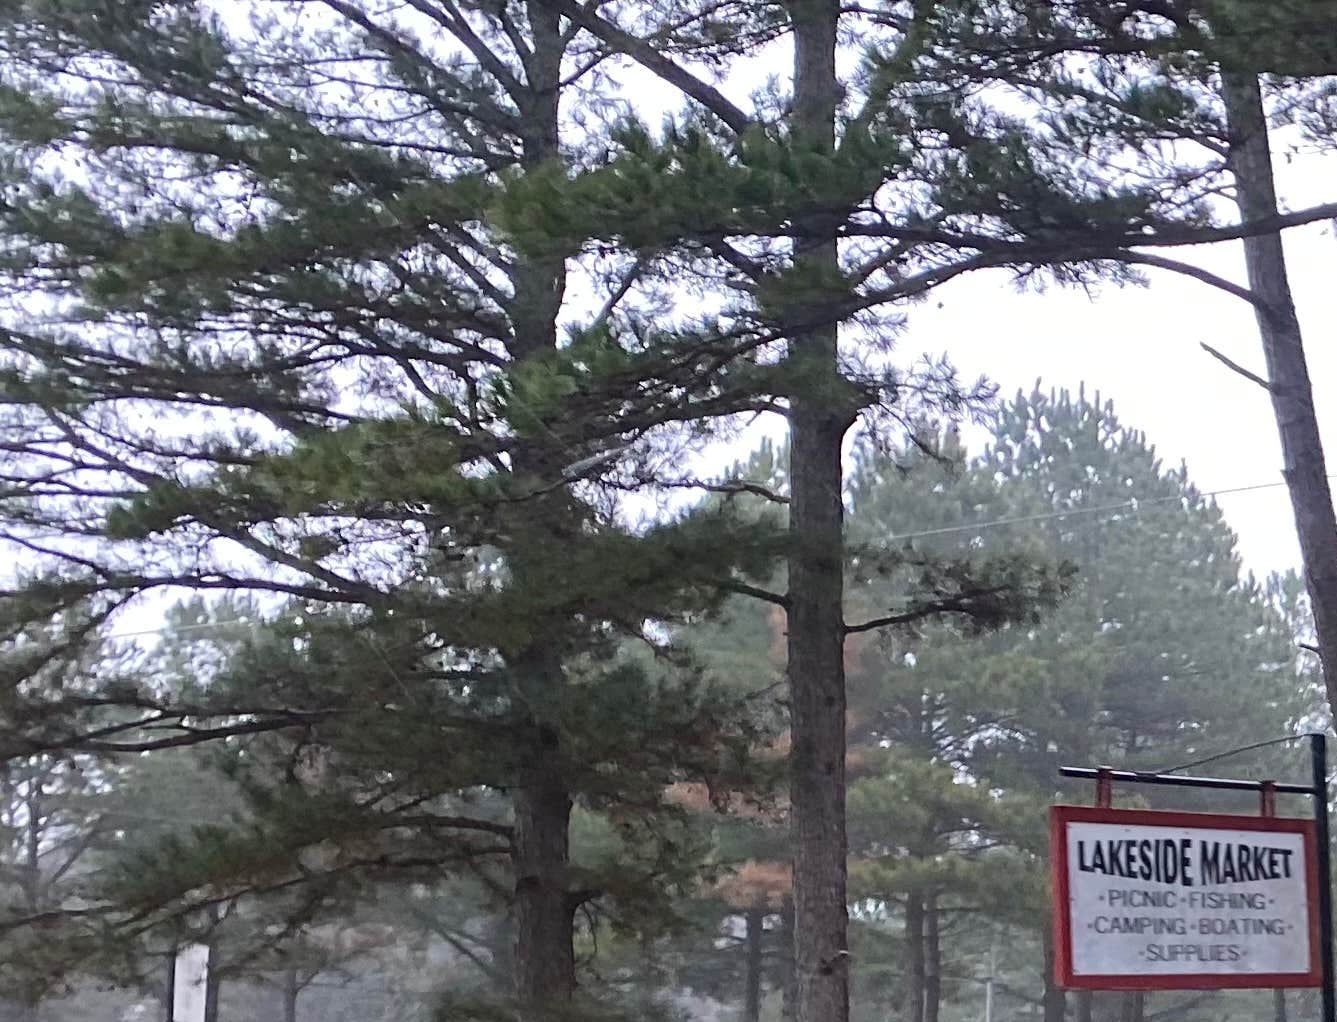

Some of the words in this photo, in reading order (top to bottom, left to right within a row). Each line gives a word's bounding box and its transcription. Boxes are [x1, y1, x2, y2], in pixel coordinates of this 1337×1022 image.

[1077, 839, 1192, 886] LAKESIDE
[1201, 840, 1293, 885] MARKET
[1108, 889, 1177, 908] PICNIC
[1188, 892, 1266, 910] FISHING
[1093, 915, 1186, 935] CAMPING
[1198, 918, 1285, 935] BOATING
[1146, 944, 1241, 961] SUPPLIES
